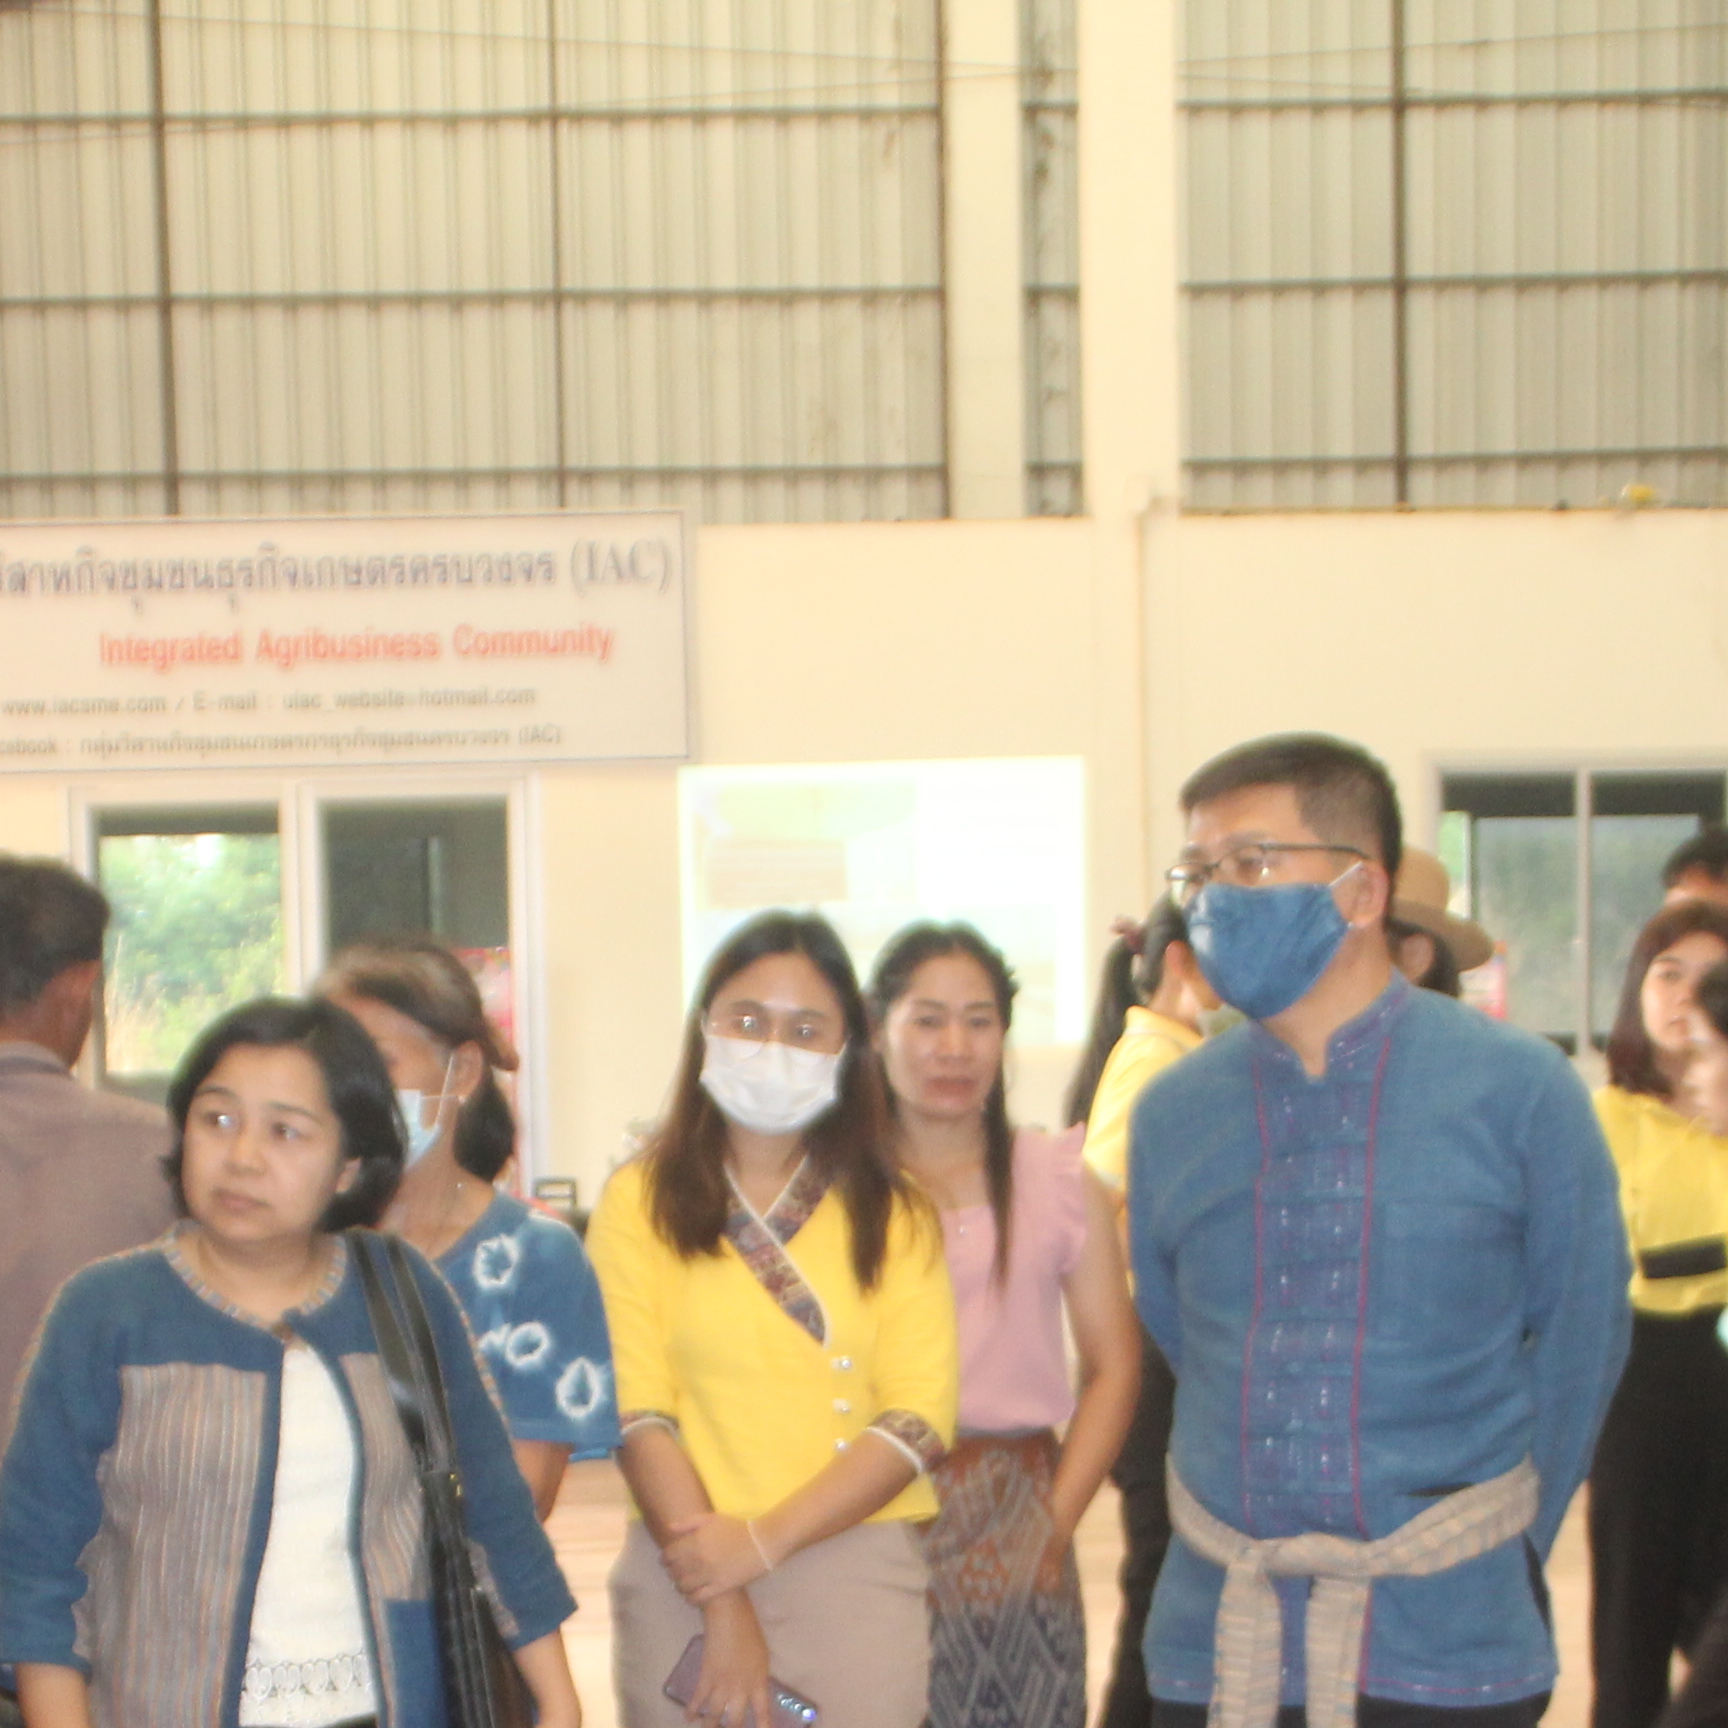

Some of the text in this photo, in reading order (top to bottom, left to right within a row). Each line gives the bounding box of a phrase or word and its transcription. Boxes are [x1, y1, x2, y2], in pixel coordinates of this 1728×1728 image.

[570, 537, 671, 598] (IAC)
[100, 623, 614, 673] Integrated Agribusiness Community
[193, 690, 258, 711] E-mail
